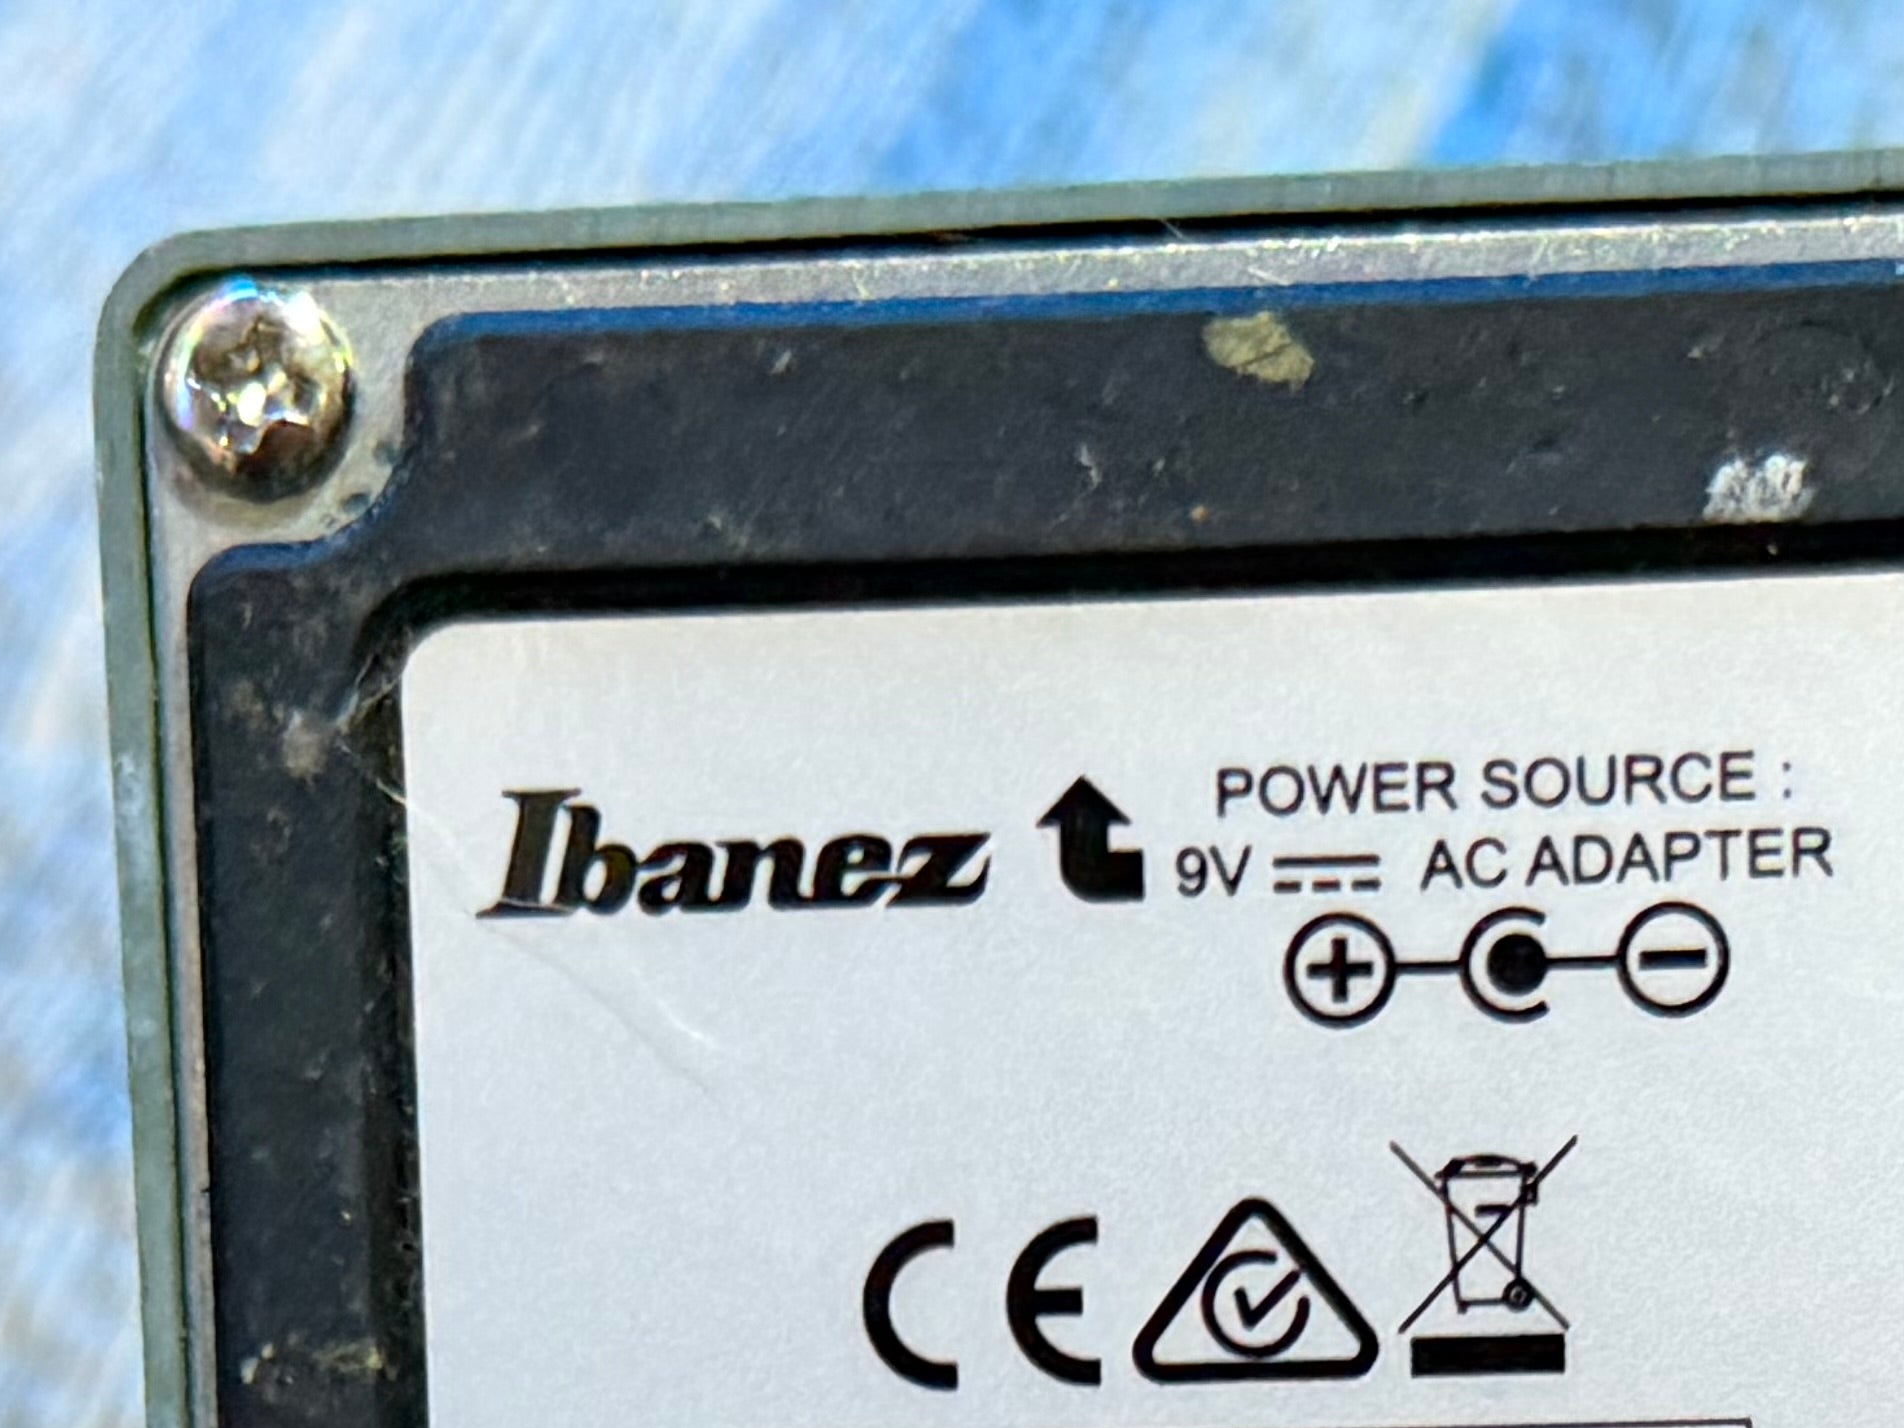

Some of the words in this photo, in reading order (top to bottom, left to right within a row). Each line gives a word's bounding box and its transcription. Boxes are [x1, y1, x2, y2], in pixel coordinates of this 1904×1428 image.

[1216, 760, 1458, 818] POWER
[1480, 750, 1756, 810] SOURCE
[476, 788, 992, 920] Ibanez
[1174, 844, 1252, 898] 9V
[1419, 836, 1508, 891] AC
[1525, 826, 1834, 887] ADAPTER
[862, 1215, 1102, 1392] CE
